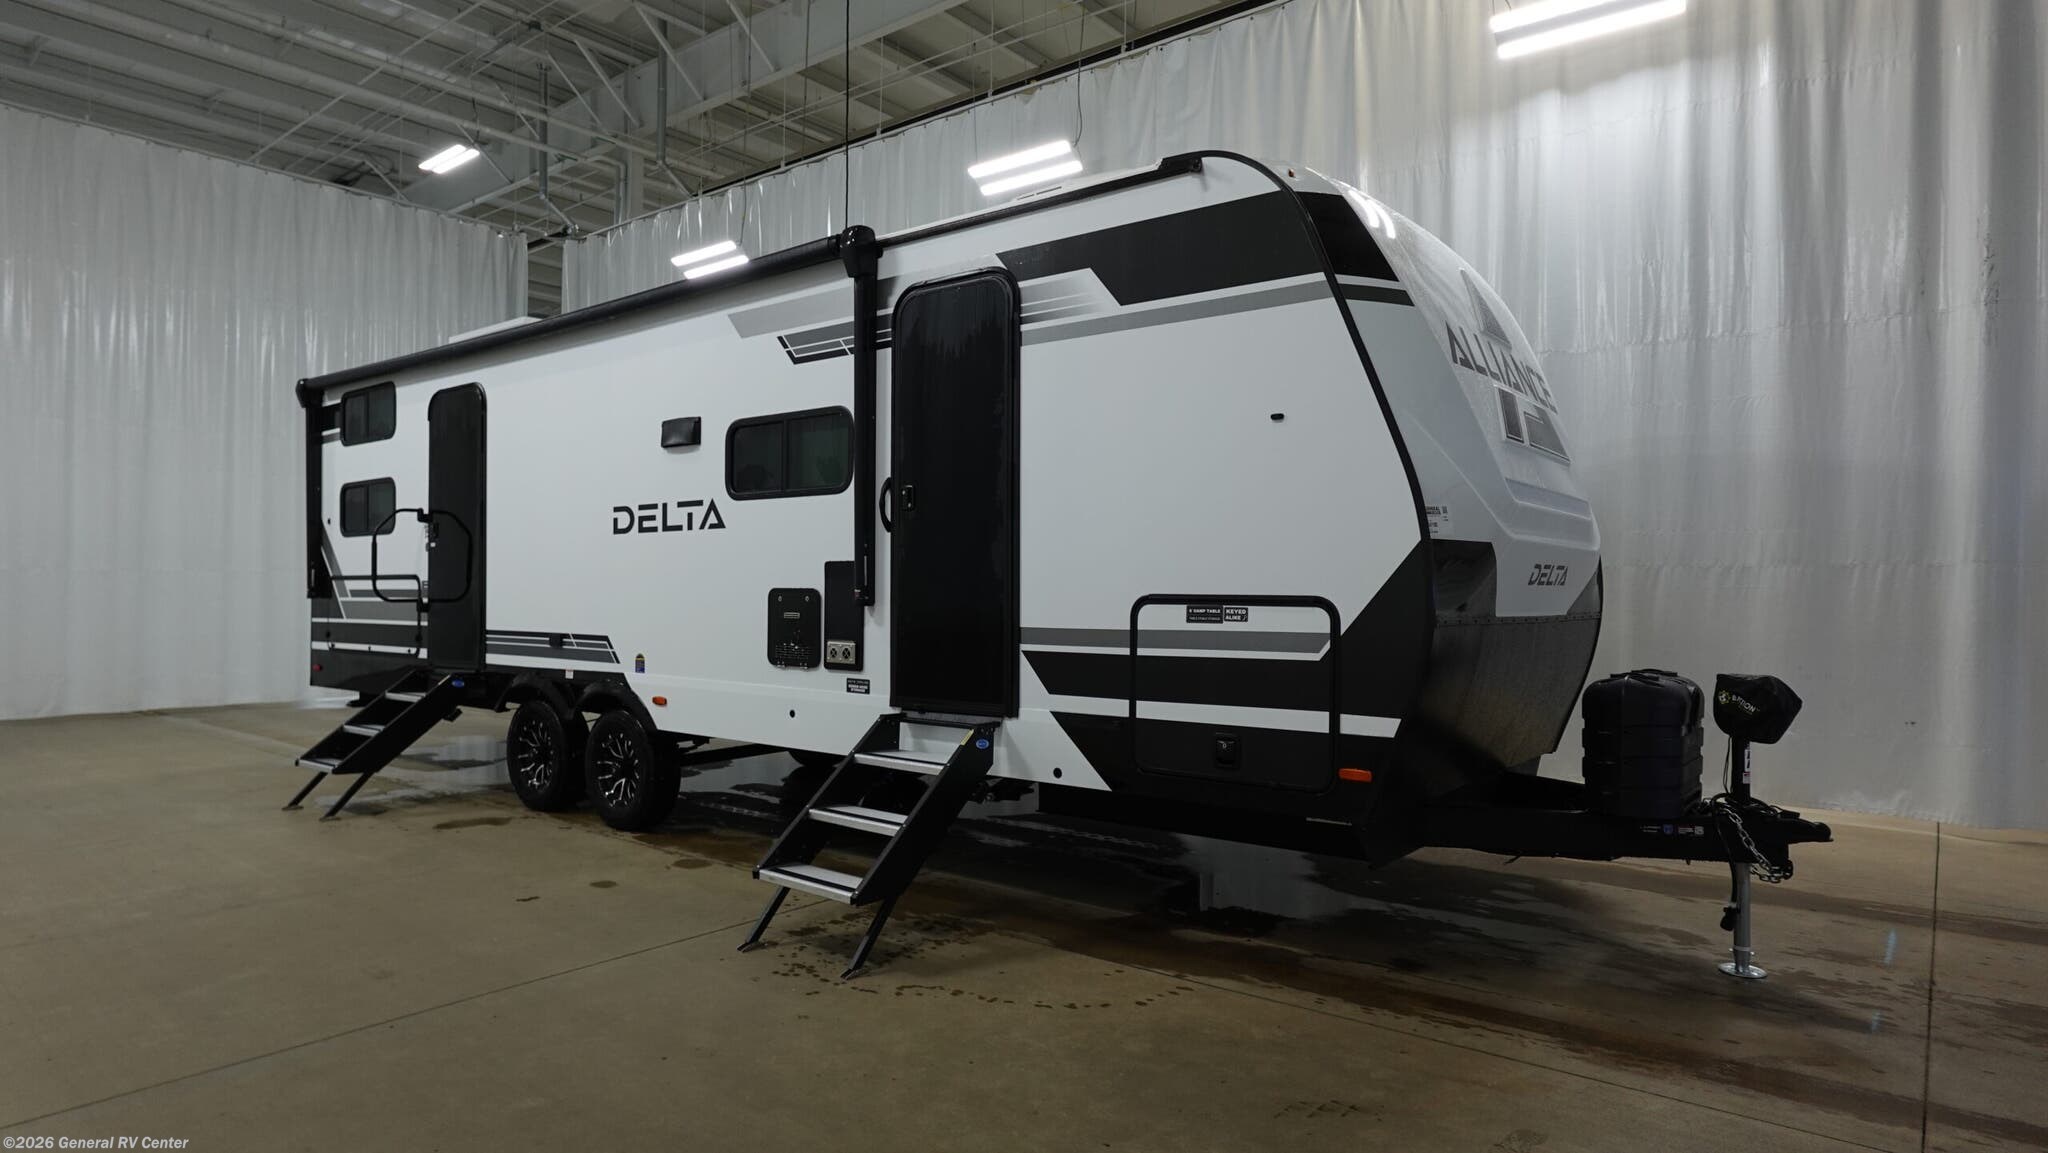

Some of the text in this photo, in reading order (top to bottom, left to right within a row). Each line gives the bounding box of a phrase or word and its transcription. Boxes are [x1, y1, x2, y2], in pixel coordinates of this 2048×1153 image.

[1446, 320, 1559, 415] ALLIANCE
[613, 498, 726, 535] DELTA
[1528, 563, 1569, 586] DELTA
